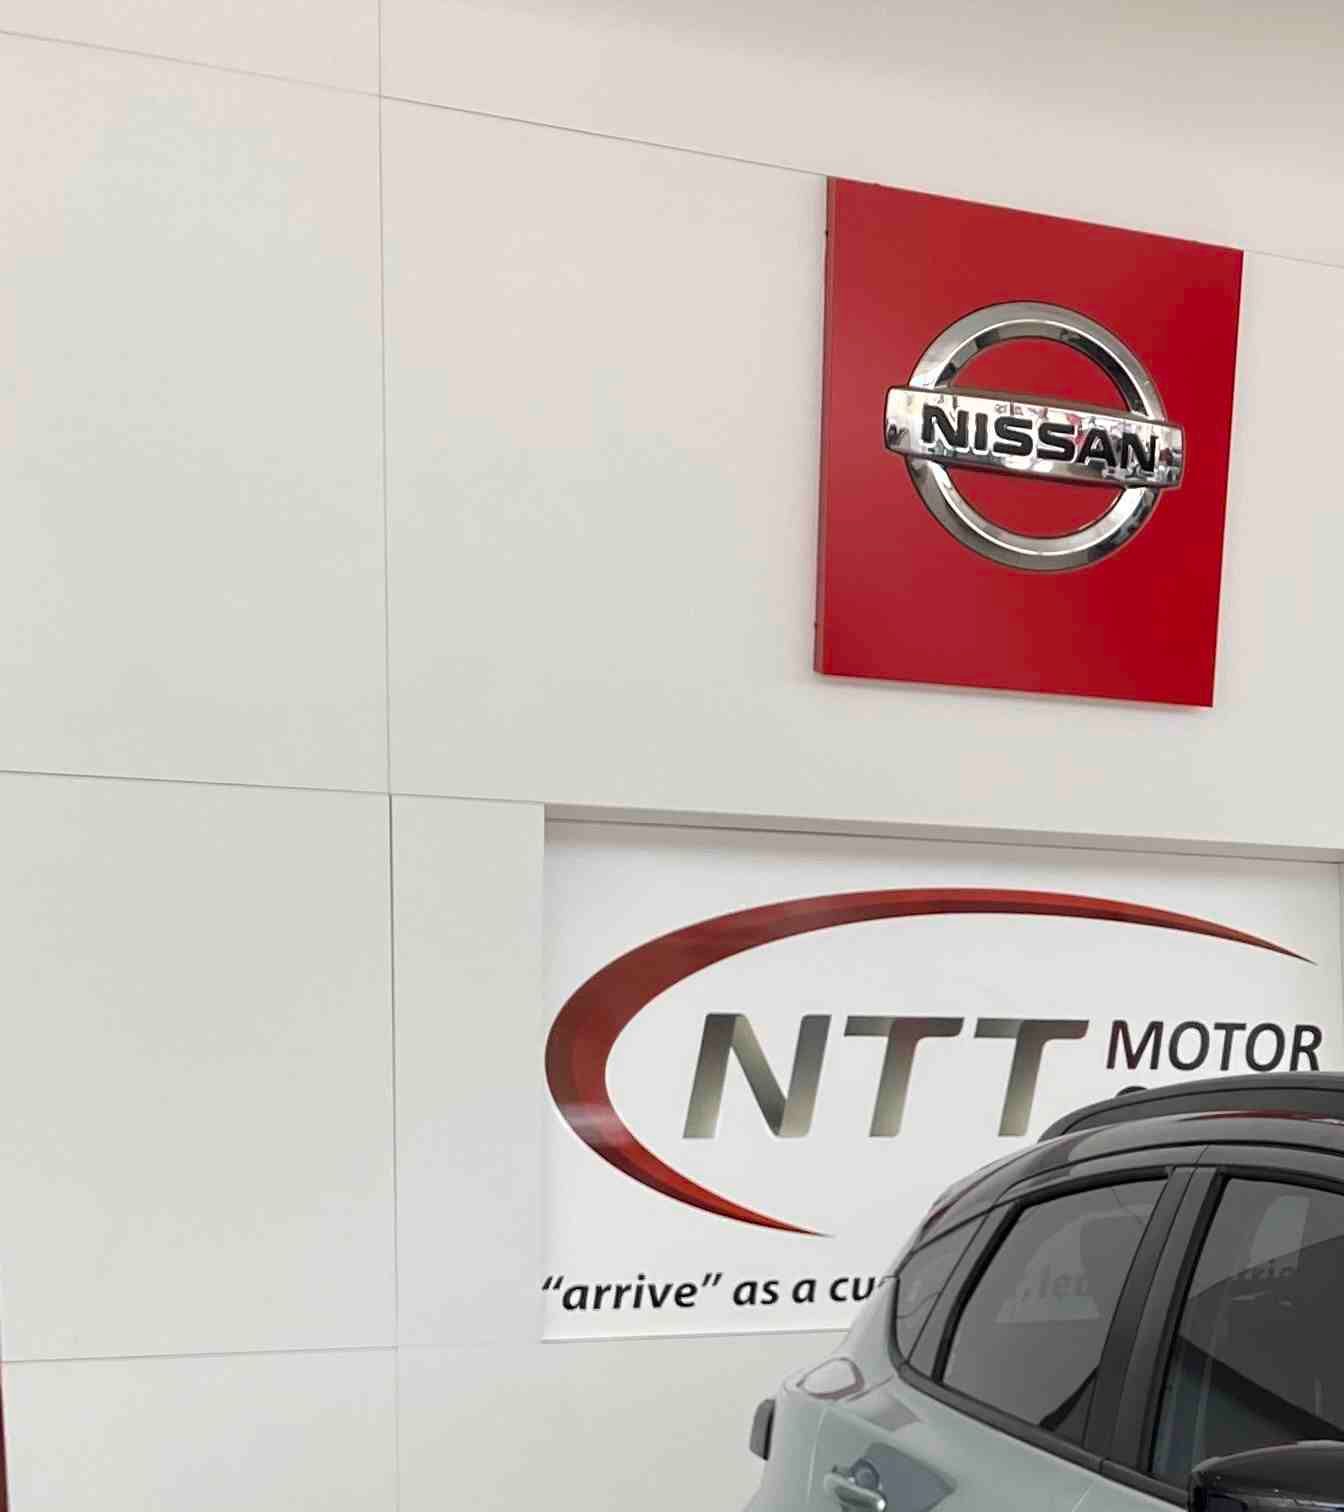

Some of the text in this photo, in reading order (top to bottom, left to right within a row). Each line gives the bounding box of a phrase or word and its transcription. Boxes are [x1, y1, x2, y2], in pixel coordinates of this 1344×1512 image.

[922, 403, 1160, 473] NISSAN
[682, 1012, 1322, 1138] NTT MOTOR
[732, 1280, 779, 1306] as
[791, 1279, 817, 1304] a
[829, 1277, 876, 1303] cu
